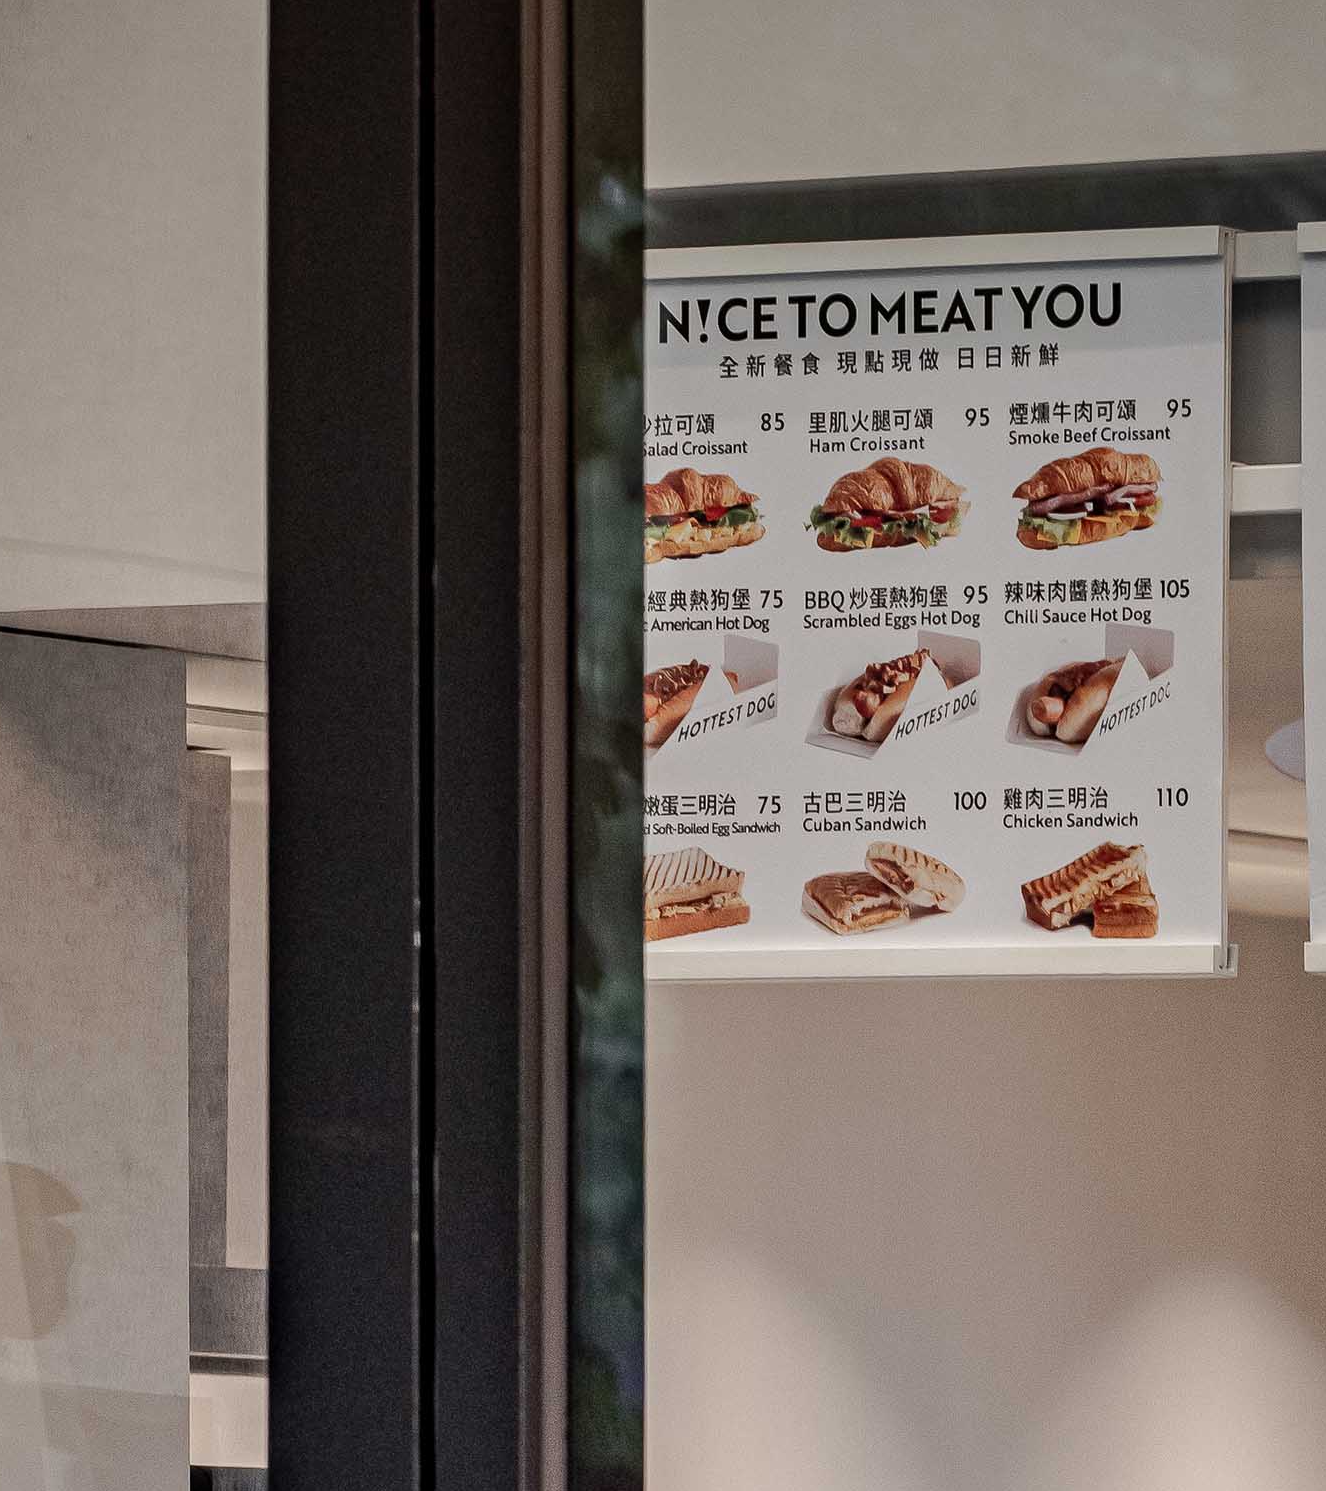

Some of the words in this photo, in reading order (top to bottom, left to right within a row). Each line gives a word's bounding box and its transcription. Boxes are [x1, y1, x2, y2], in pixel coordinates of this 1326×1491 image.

[660, 297, 778, 343] N!CE
[788, 293, 856, 338] TO
[871, 288, 1002, 335] MEAT
[1011, 283, 1121, 329] YOU
[719, 352, 820, 378] 全新餐食
[837, 348, 939, 373] 現點現做
[959, 343, 1058, 369] 日日新鮮
[1167, 399, 1191, 417] 95
[761, 413, 784, 431] 85
[809, 409, 932, 433] 里肌火腿可頌
[966, 408, 989, 426] 95
[811, 439, 845, 453] Ham
[850, 437, 924, 451] Croissant
[1009, 429, 1059, 445] Smoke
[1064, 428, 1097, 443] Beef
[1101, 427, 1170, 441] Croissant
[682, 441, 747, 455] Croissant
[1160, 579, 1189, 598] 105
[761, 590, 783, 608] 75
[806, 590, 844, 613] BBQ
[850, 586, 948, 609] 炒蛋熱狗堡
[964, 586, 988, 604] 95
[651, 617, 712, 631] American
[716, 616, 740, 630] Hot
[744, 616, 769, 633] Dog
[804, 613, 880, 628] Scrambled
[885, 613, 916, 630] Eggs
[922, 611, 947, 625] Hot
[952, 611, 980, 628] Dog
[1005, 610, 1037, 624] Chili
[1043, 609, 1086, 623] Sauce
[1091, 608, 1118, 622] Hot
[1123, 607, 1151, 624] Dog
[678, 705, 743, 742] HOTTEST
[758, 796, 781, 814] 75
[804, 790, 906, 814] 古巴三明治
[954, 792, 986, 810] 100
[1004, 787, 1108, 810] 雞肉三明治
[1157, 788, 1188, 806] 110
[803, 818, 850, 832] Cuban
[855, 816, 926, 831] Sandwich
[1003, 814, 1062, 828] Chicken
[1067, 812, 1138, 827] Sandwich
[653, 823, 709, 834] Soft-Boiled
[712, 823, 730, 837] Egg
[732, 822, 780, 833] Sandwich
